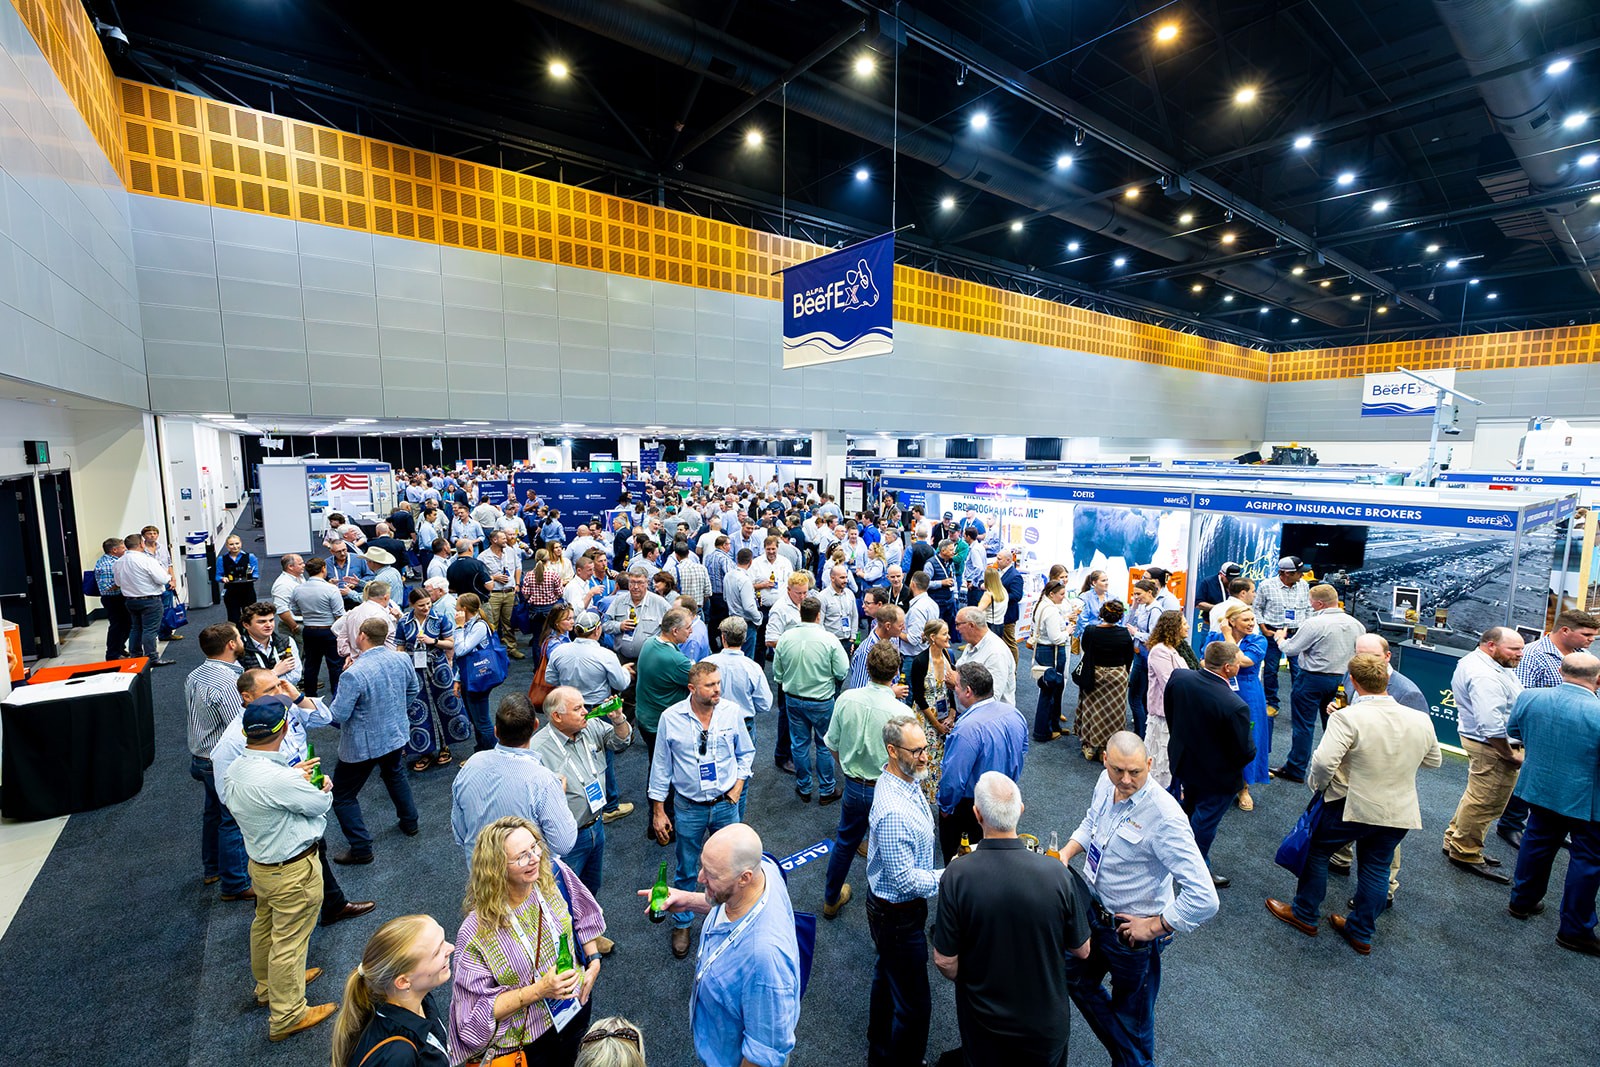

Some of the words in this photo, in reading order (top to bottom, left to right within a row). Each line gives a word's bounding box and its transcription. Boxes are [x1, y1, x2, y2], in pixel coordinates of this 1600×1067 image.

[805, 286, 824, 297] ALFA
[1072, 490, 1095, 499] ZOETIS
[1199, 498, 1210, 506] 39
[1245, 501, 1293, 512] AGRIPRO
[1295, 503, 1362, 516] INSURANCE
[1365, 508, 1422, 520] BROKERS
